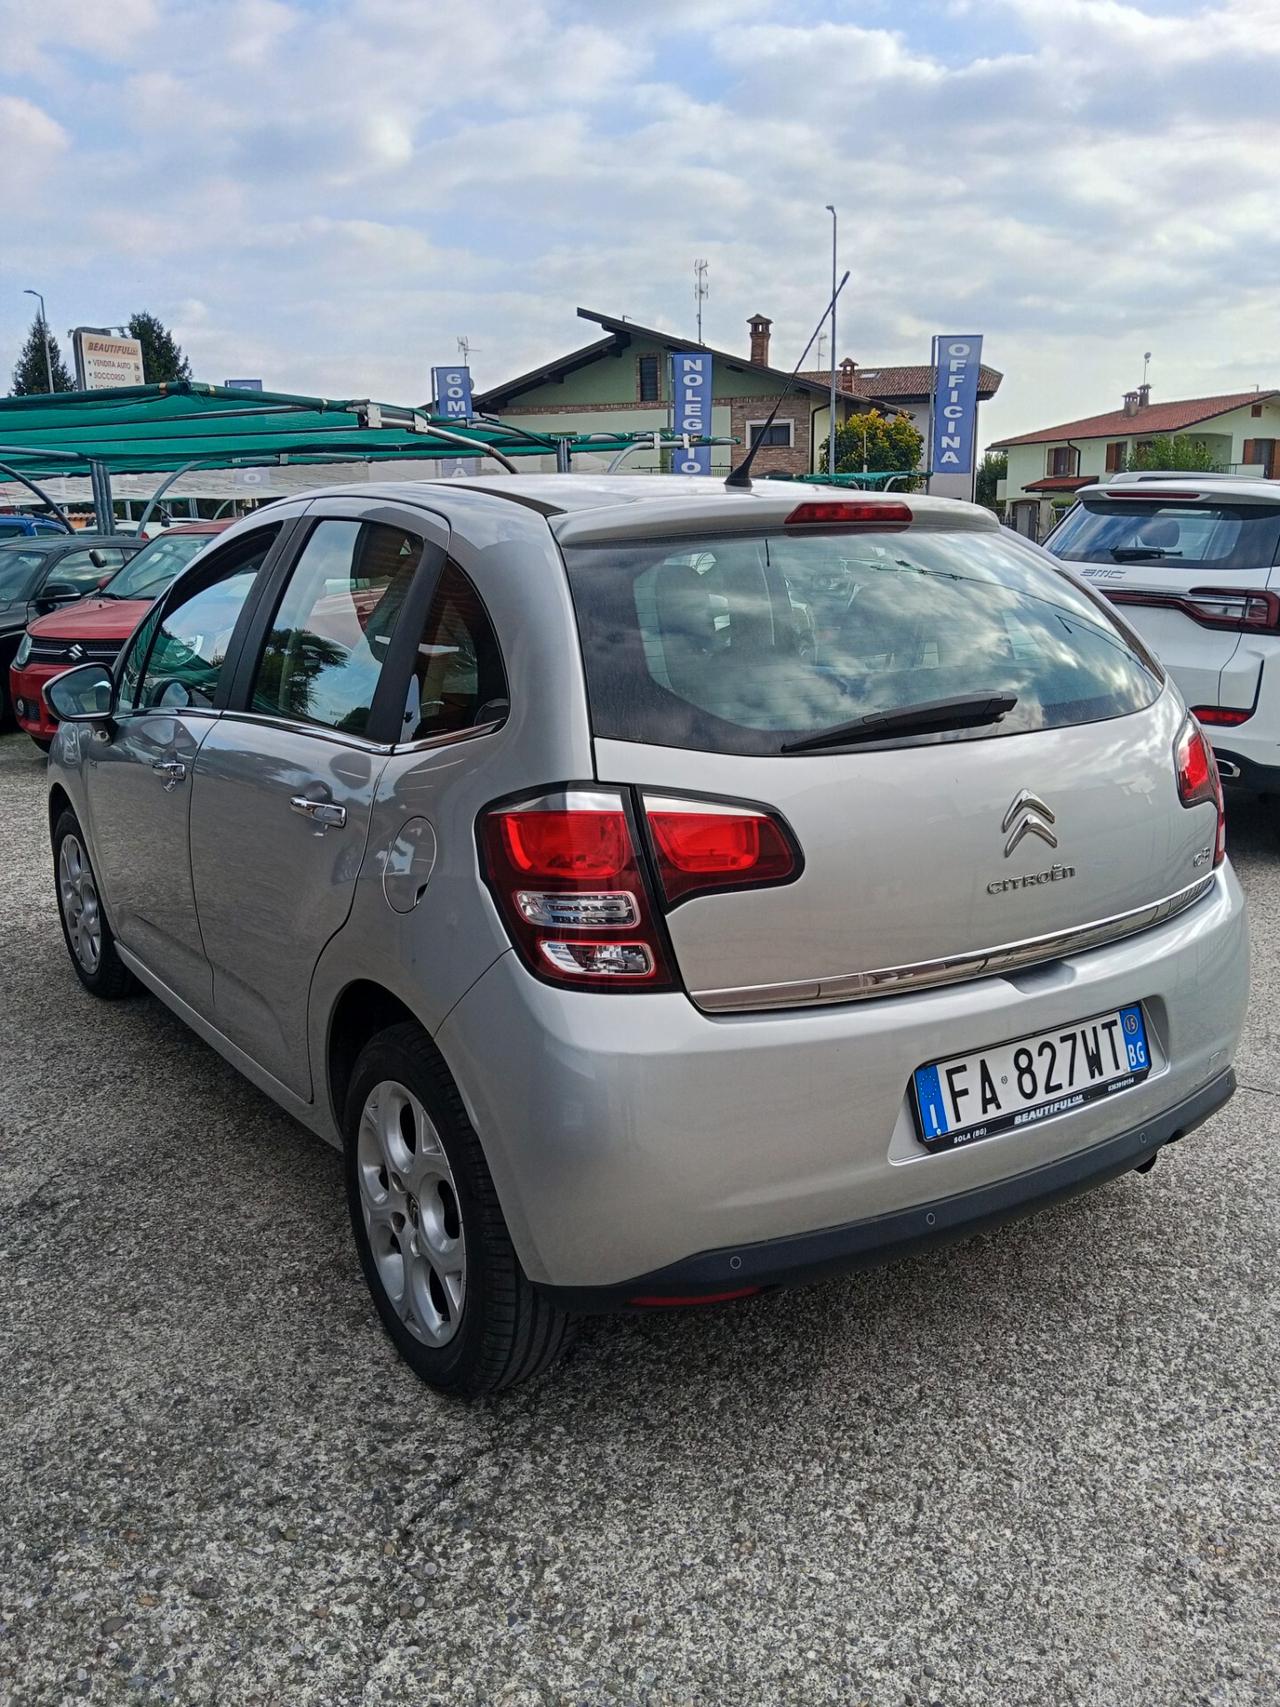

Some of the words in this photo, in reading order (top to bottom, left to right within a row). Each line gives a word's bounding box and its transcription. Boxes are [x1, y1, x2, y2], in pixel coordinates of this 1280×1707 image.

[88, 342, 130, 355] BEAUTIFUL
[93, 359, 116, 368] VENDITA
[117, 361, 131, 370] AUTO
[94, 371, 126, 381] SOCCORSO
[940, 343, 970, 463] OFFICINA
[681, 359, 703, 474] NOLEGIO
[1126, 1018, 1136, 1031] 15
[1128, 1042, 1145, 1066] BG
[945, 1058, 1002, 1123] FA
[1013, 1019, 1121, 1100] 827WT
[953, 1133, 972, 1144] SOLA
